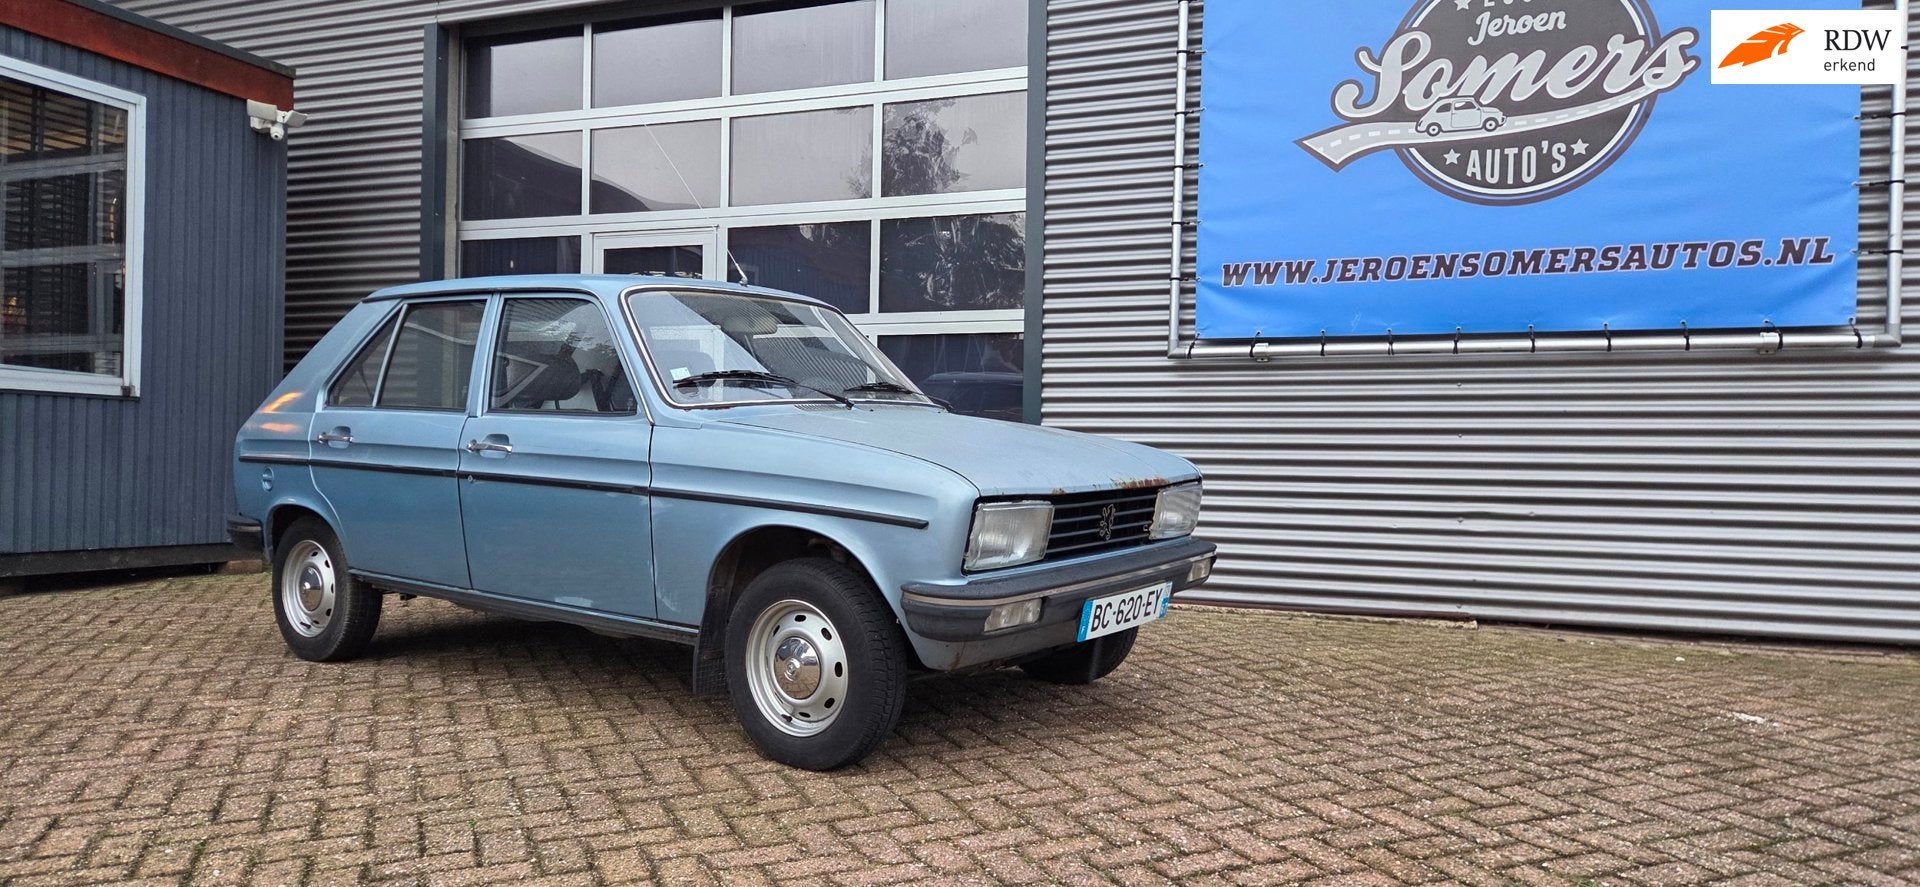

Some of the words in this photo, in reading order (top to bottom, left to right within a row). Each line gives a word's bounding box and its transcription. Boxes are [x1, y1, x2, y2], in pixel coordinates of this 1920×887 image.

[1467, 11, 1567, 46] Jeroen
[1334, 31, 1696, 118] Somers
[1466, 140, 1566, 184] AUTO'S
[1221, 235, 1834, 288] WWW.JEROENSOMERSAUTOS.NL
[1090, 588, 1163, 632] BC-620-EY
